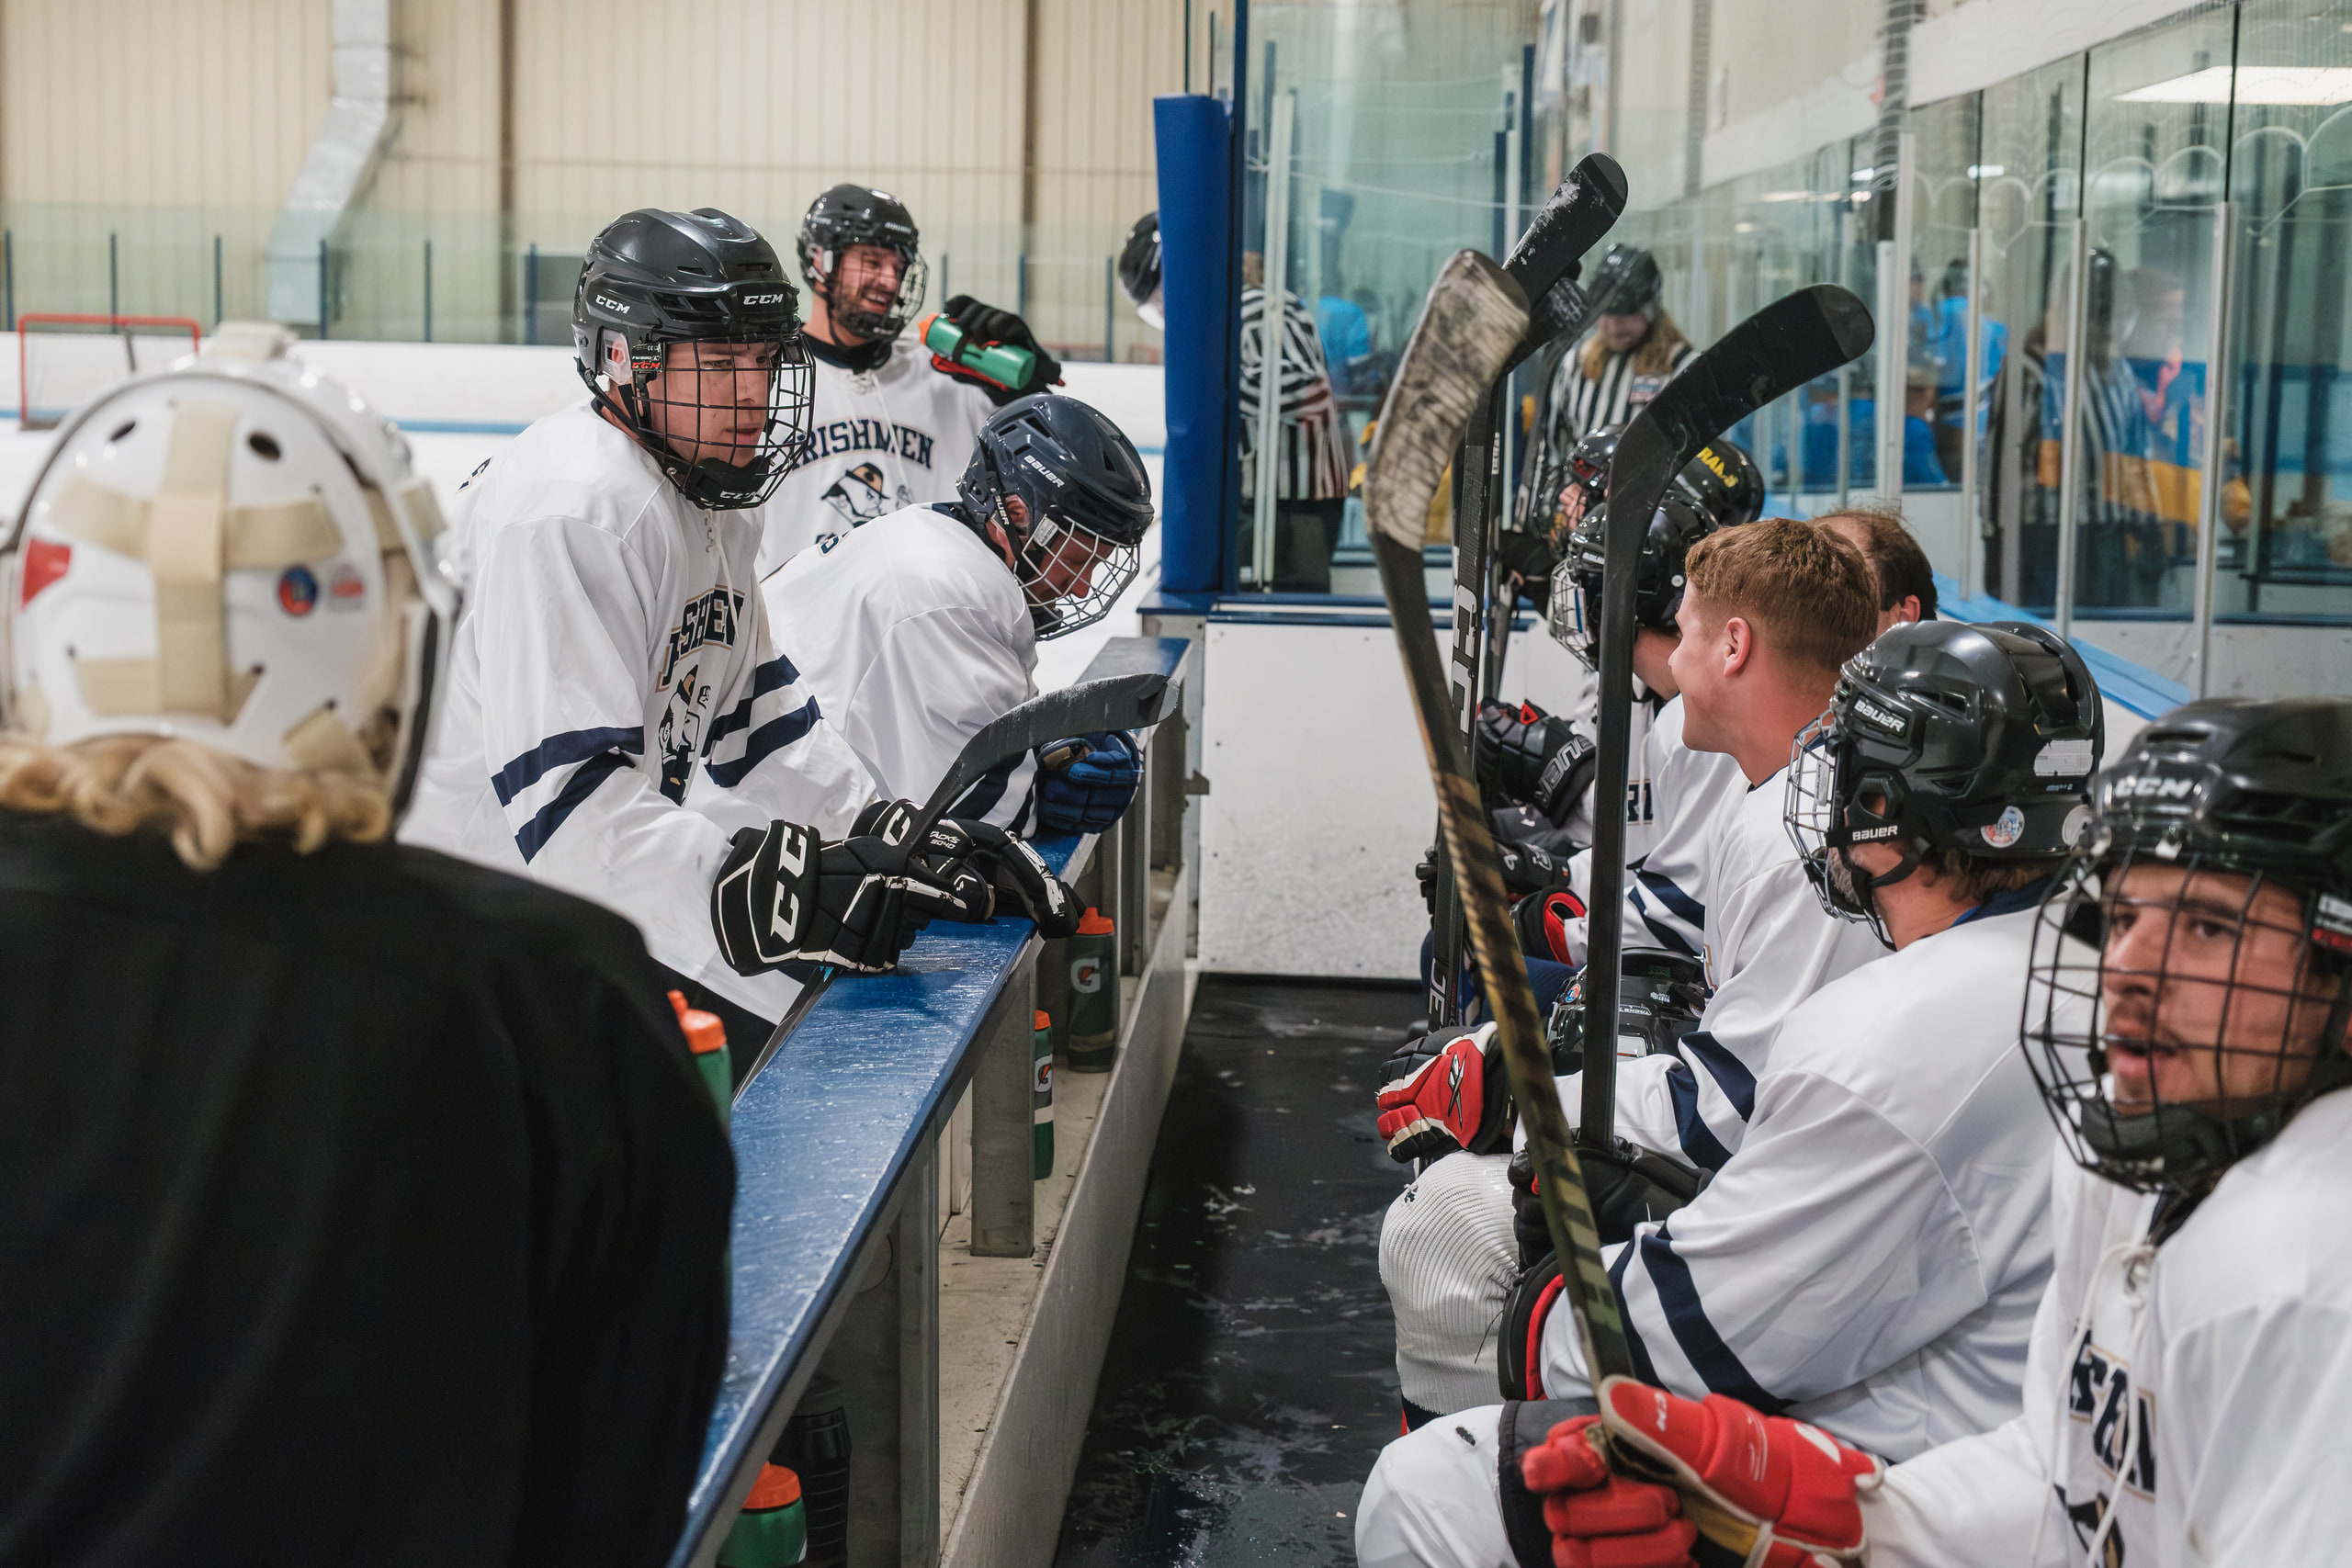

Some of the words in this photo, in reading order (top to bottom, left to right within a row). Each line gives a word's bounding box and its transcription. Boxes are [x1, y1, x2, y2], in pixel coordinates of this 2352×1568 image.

[595, 295, 631, 314] CCM
[743, 294, 783, 305] CCM
[1023, 455, 1065, 488] BAUER
[995, 496, 1010, 525] AUER
[1449, 583, 1477, 735] CC
[1854, 699, 1906, 732] BAUER
[2114, 777, 2194, 799] CCM
[1852, 825, 1898, 840] BAUER
[770, 825, 812, 943] CC
[1070, 957, 1102, 994] G
